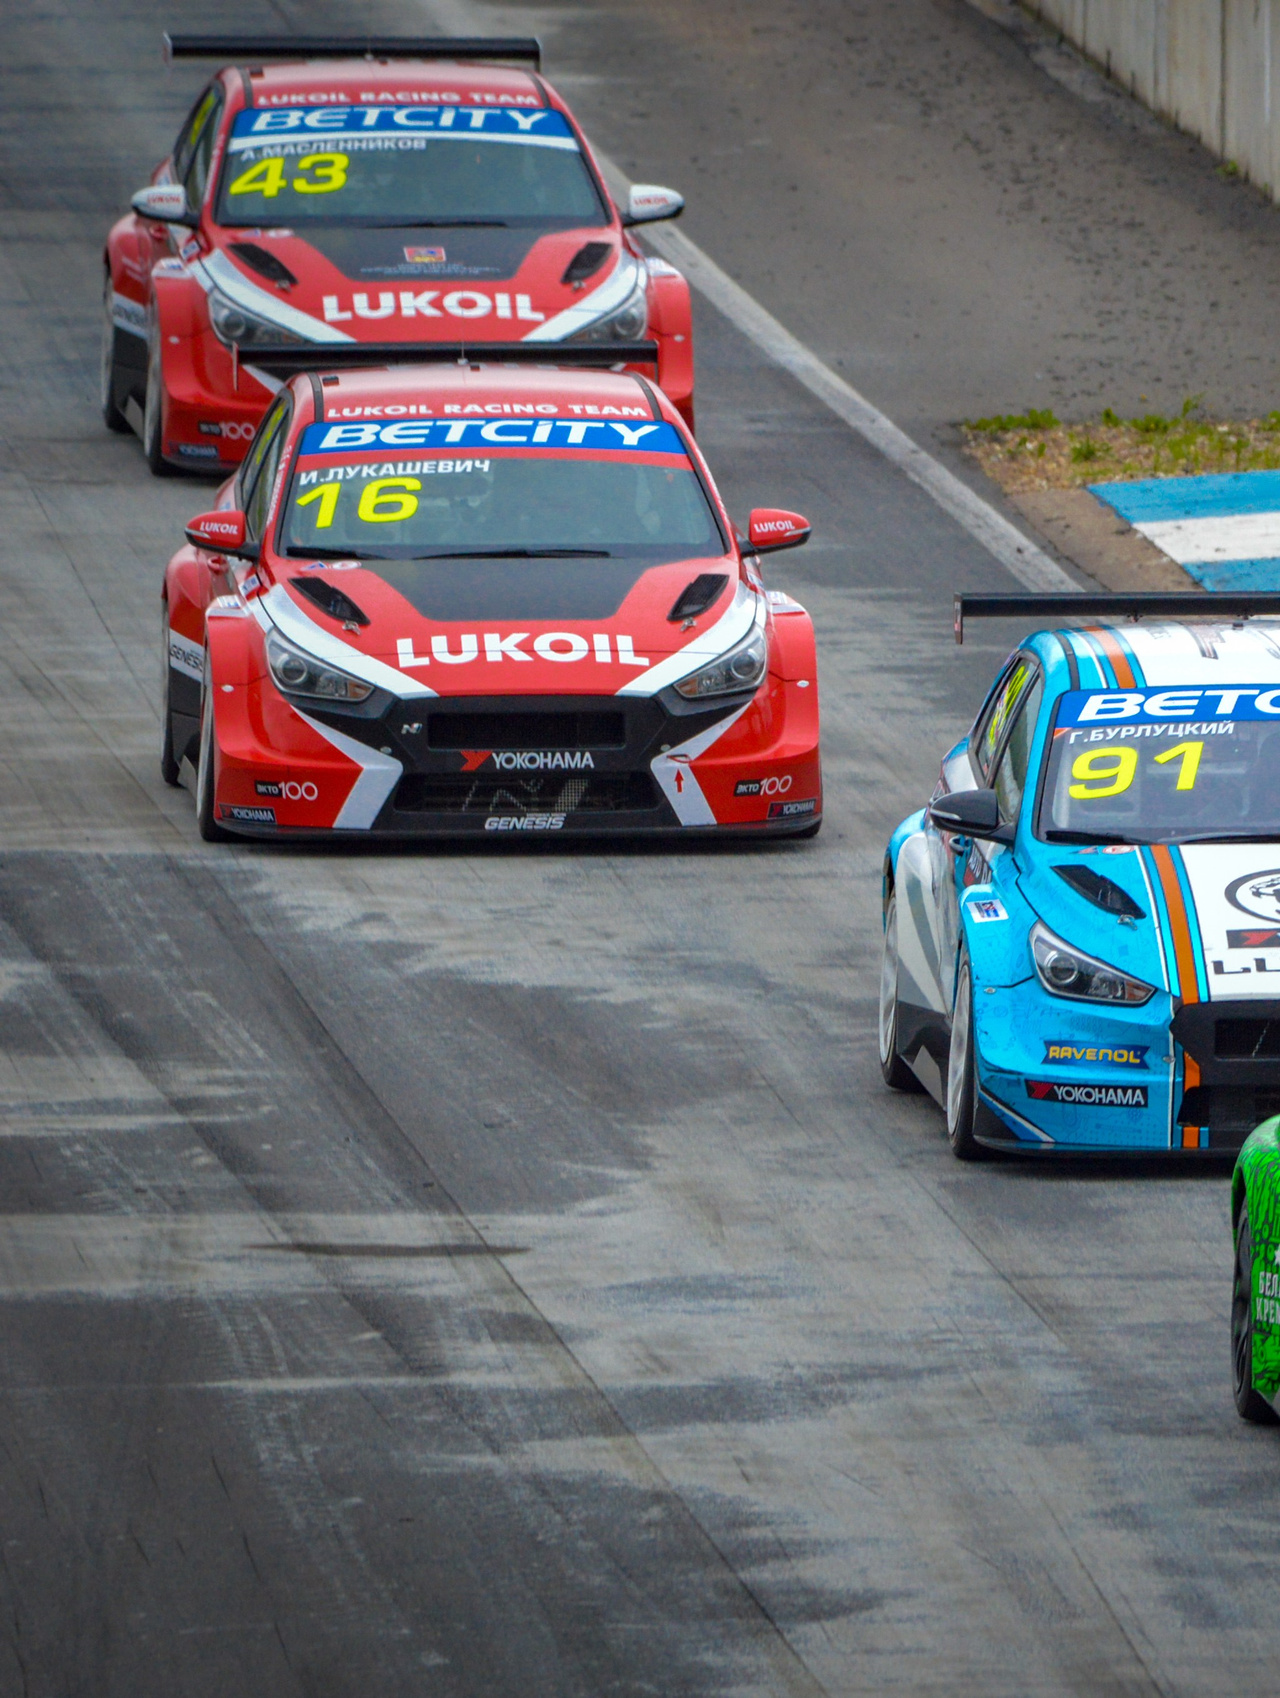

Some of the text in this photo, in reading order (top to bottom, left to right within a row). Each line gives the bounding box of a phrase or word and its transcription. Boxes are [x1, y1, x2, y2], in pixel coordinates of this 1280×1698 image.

[257, 91, 539, 106] LUKOIL RACING TEAM
[229, 152, 350, 198] 43
[322, 290, 545, 322] LUKOIL
[327, 403, 648, 418] LUKOIL RACING TEAM
[219, 422, 256, 440] 100
[299, 459, 491, 486] И.ЛУКАШЕВИЧ
[296, 476, 422, 529] 16
[200, 521, 238, 535] LUKOIL
[753, 520, 796, 533] LUKOIL
[396, 632, 651, 669] LUKOIL
[491, 751, 595, 770] YOKOHAMA
[1068, 741, 1204, 800] 91
[278, 781, 319, 801] 100
[760, 775, 793, 796] 100
[231, 807, 275, 821] YOKOHAMA
[484, 816, 566, 831] GENESIS
[1048, 1046, 1141, 1064] RAVENOL
[1053, 1085, 1146, 1106] YOKOHAMA
